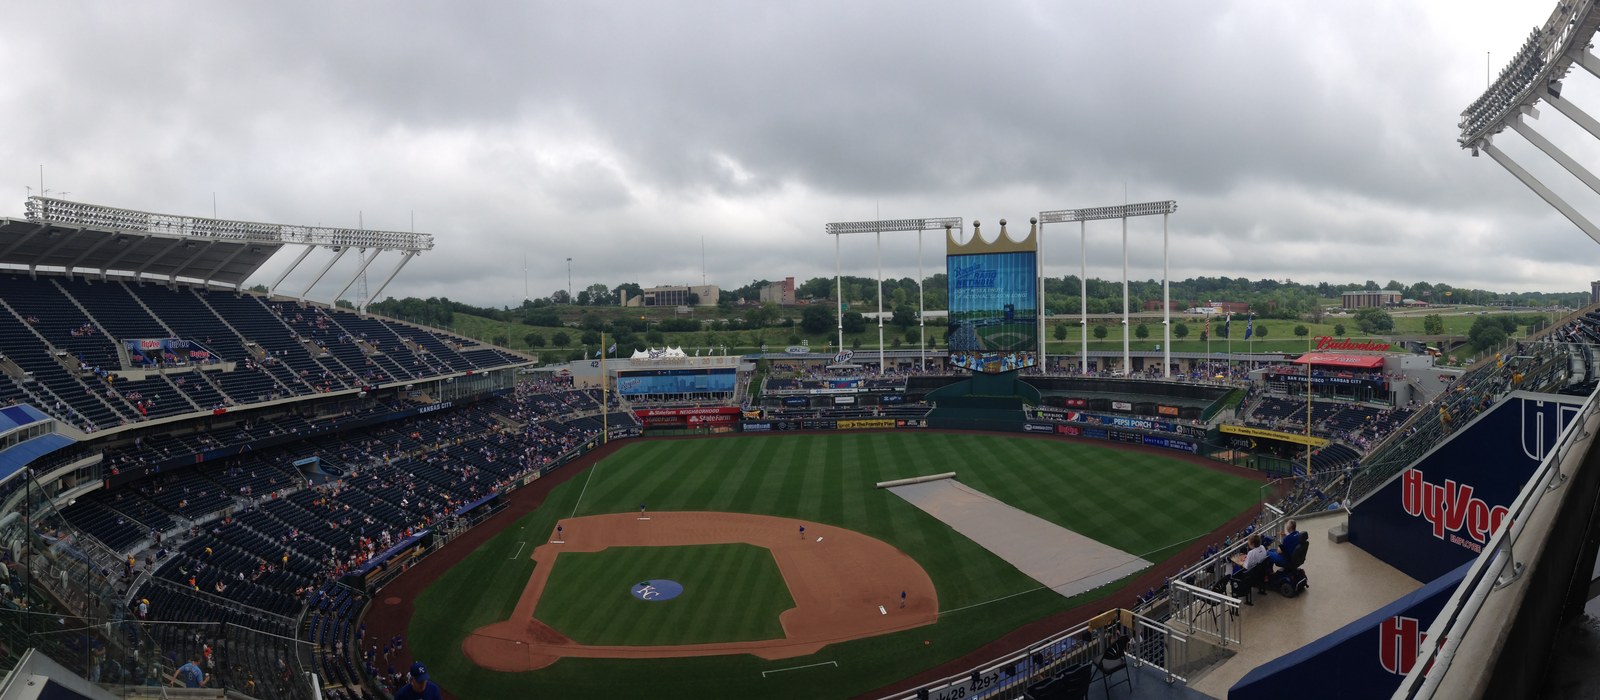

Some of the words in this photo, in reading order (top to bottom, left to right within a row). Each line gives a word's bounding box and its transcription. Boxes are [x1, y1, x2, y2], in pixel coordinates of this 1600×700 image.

[1313, 336, 1390, 352] Budweiser
[838, 352, 852, 363] Lite
[419, 404, 440, 413] KANSAS
[1114, 418, 1130, 426] PEPSI
[1131, 420, 1152, 428] PORCH
[1230, 436, 1249, 448] Sprint
[946, 686, 965, 700] 428
[969, 678, 989, 692] 429
